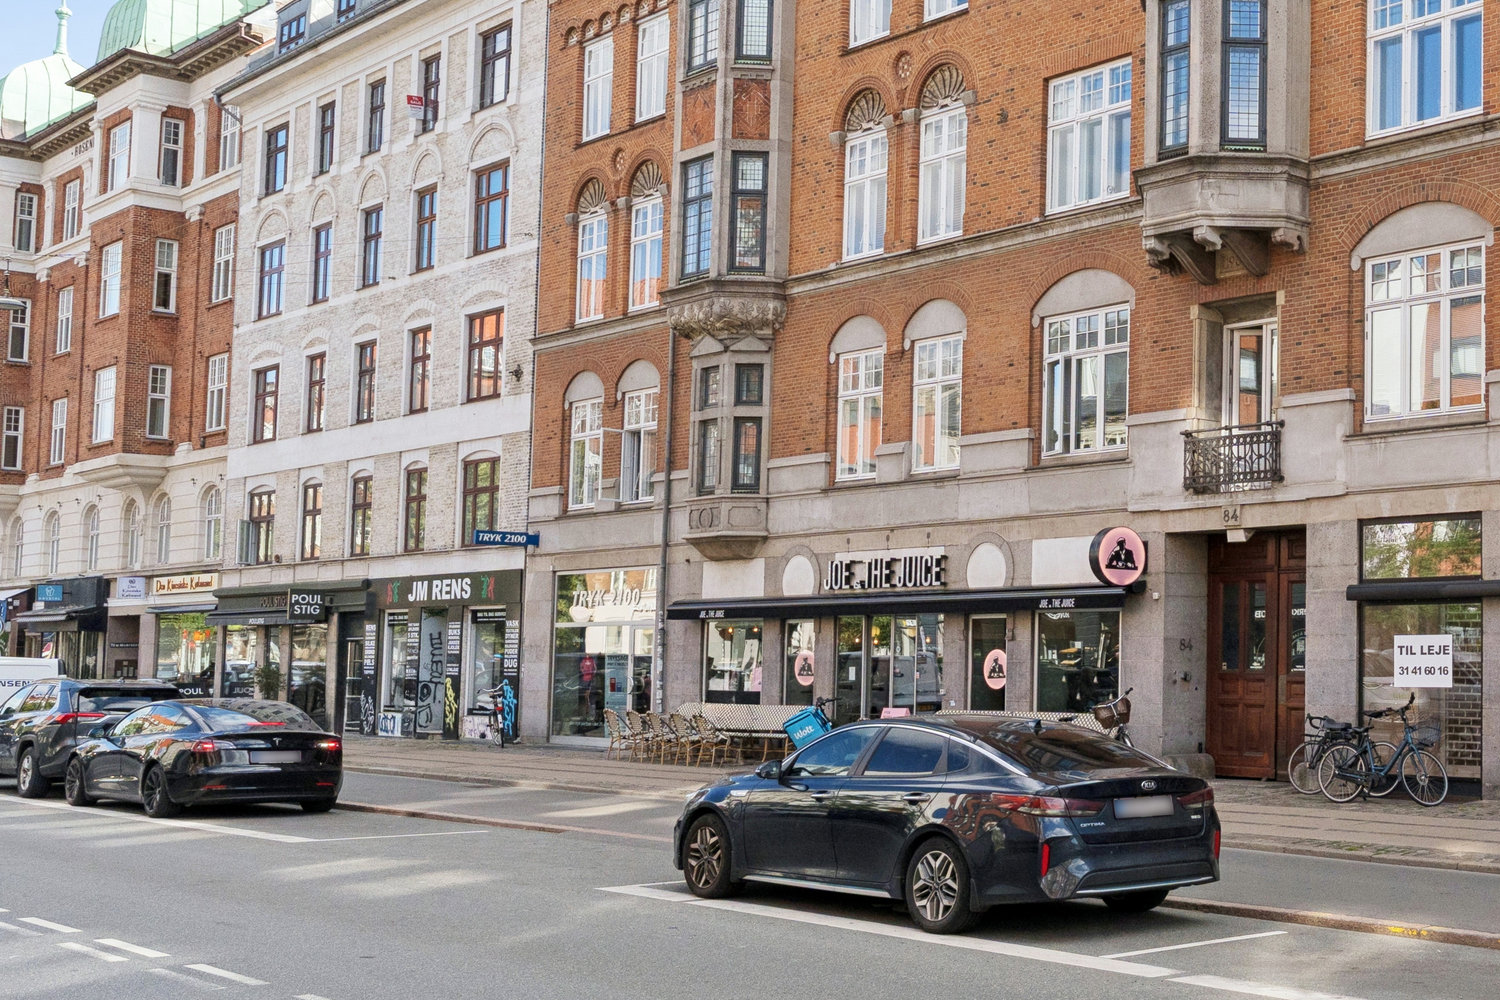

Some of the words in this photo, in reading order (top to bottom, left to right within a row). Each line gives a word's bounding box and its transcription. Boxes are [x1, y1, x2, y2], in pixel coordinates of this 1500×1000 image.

[1223, 508, 1239, 523] 84
[478, 532, 503, 542] TRYK
[504, 534, 527, 544] 2100
[823, 559, 850, 590] JOE
[864, 557, 890, 589] THE
[896, 554, 942, 588] JUICE
[407, 580, 429, 602] JM
[431, 577, 472, 601] RENS
[291, 594, 323, 604] POUL
[572, 588, 607, 607] TRYK
[294, 605, 320, 615] STIG
[1179, 638, 1194, 651] 84
[1397, 645, 1417, 656] TIL
[1420, 645, 1450, 656] LEJE
[504, 659, 518, 668] DUG
[1398, 666, 1409, 676] 31
[1411, 666, 1422, 676] 41
[1424, 666, 1436, 676] 60
[1437, 666, 1449, 676] 16
[793, 725, 815, 740] Wolt
